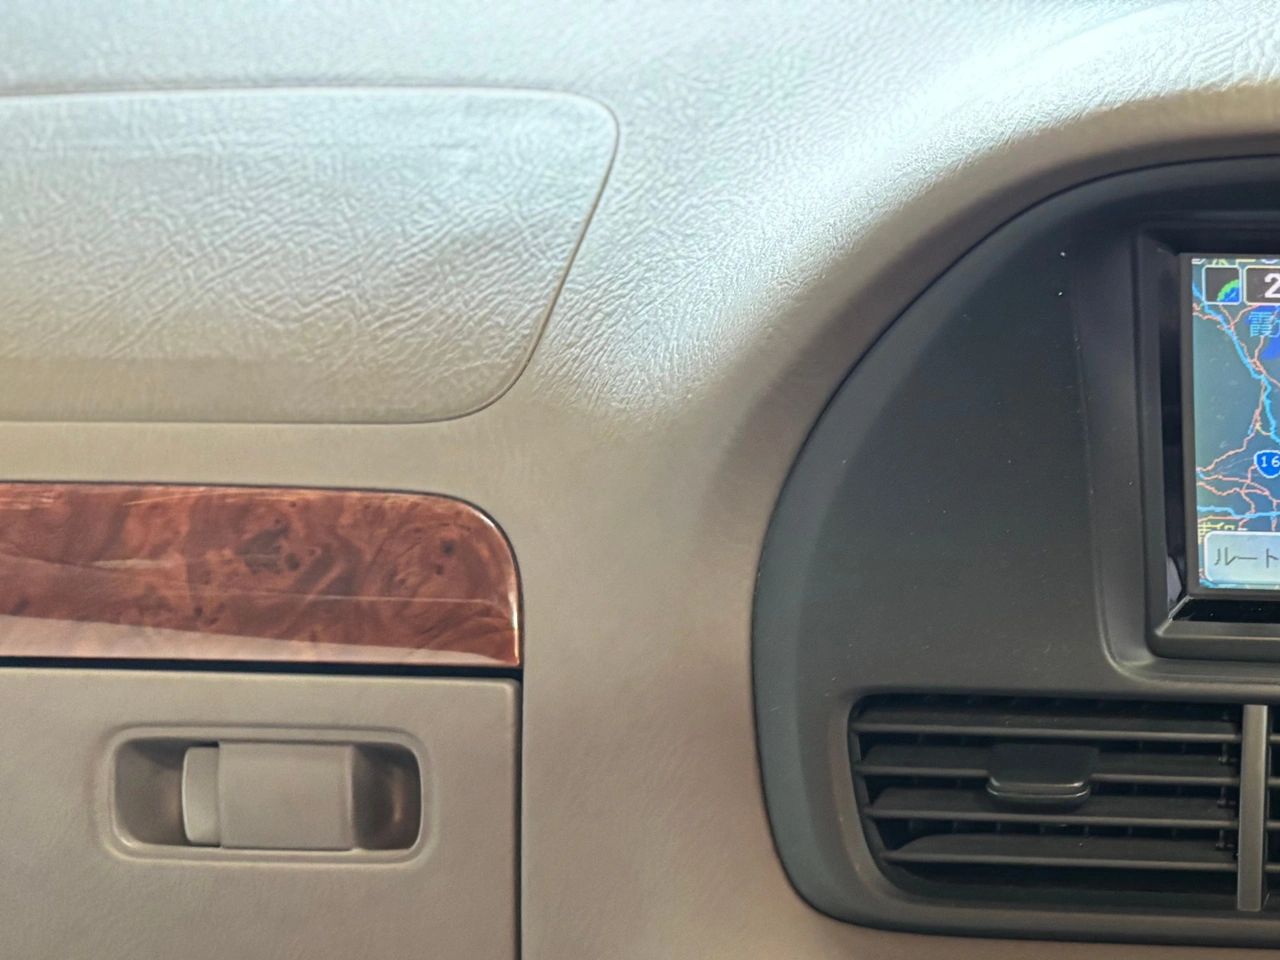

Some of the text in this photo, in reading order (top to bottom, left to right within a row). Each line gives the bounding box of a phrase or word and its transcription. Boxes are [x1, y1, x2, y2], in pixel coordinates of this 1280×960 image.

[1260, 456, 1280, 468] 16
[1214, 547, 1280, 568] ルート
